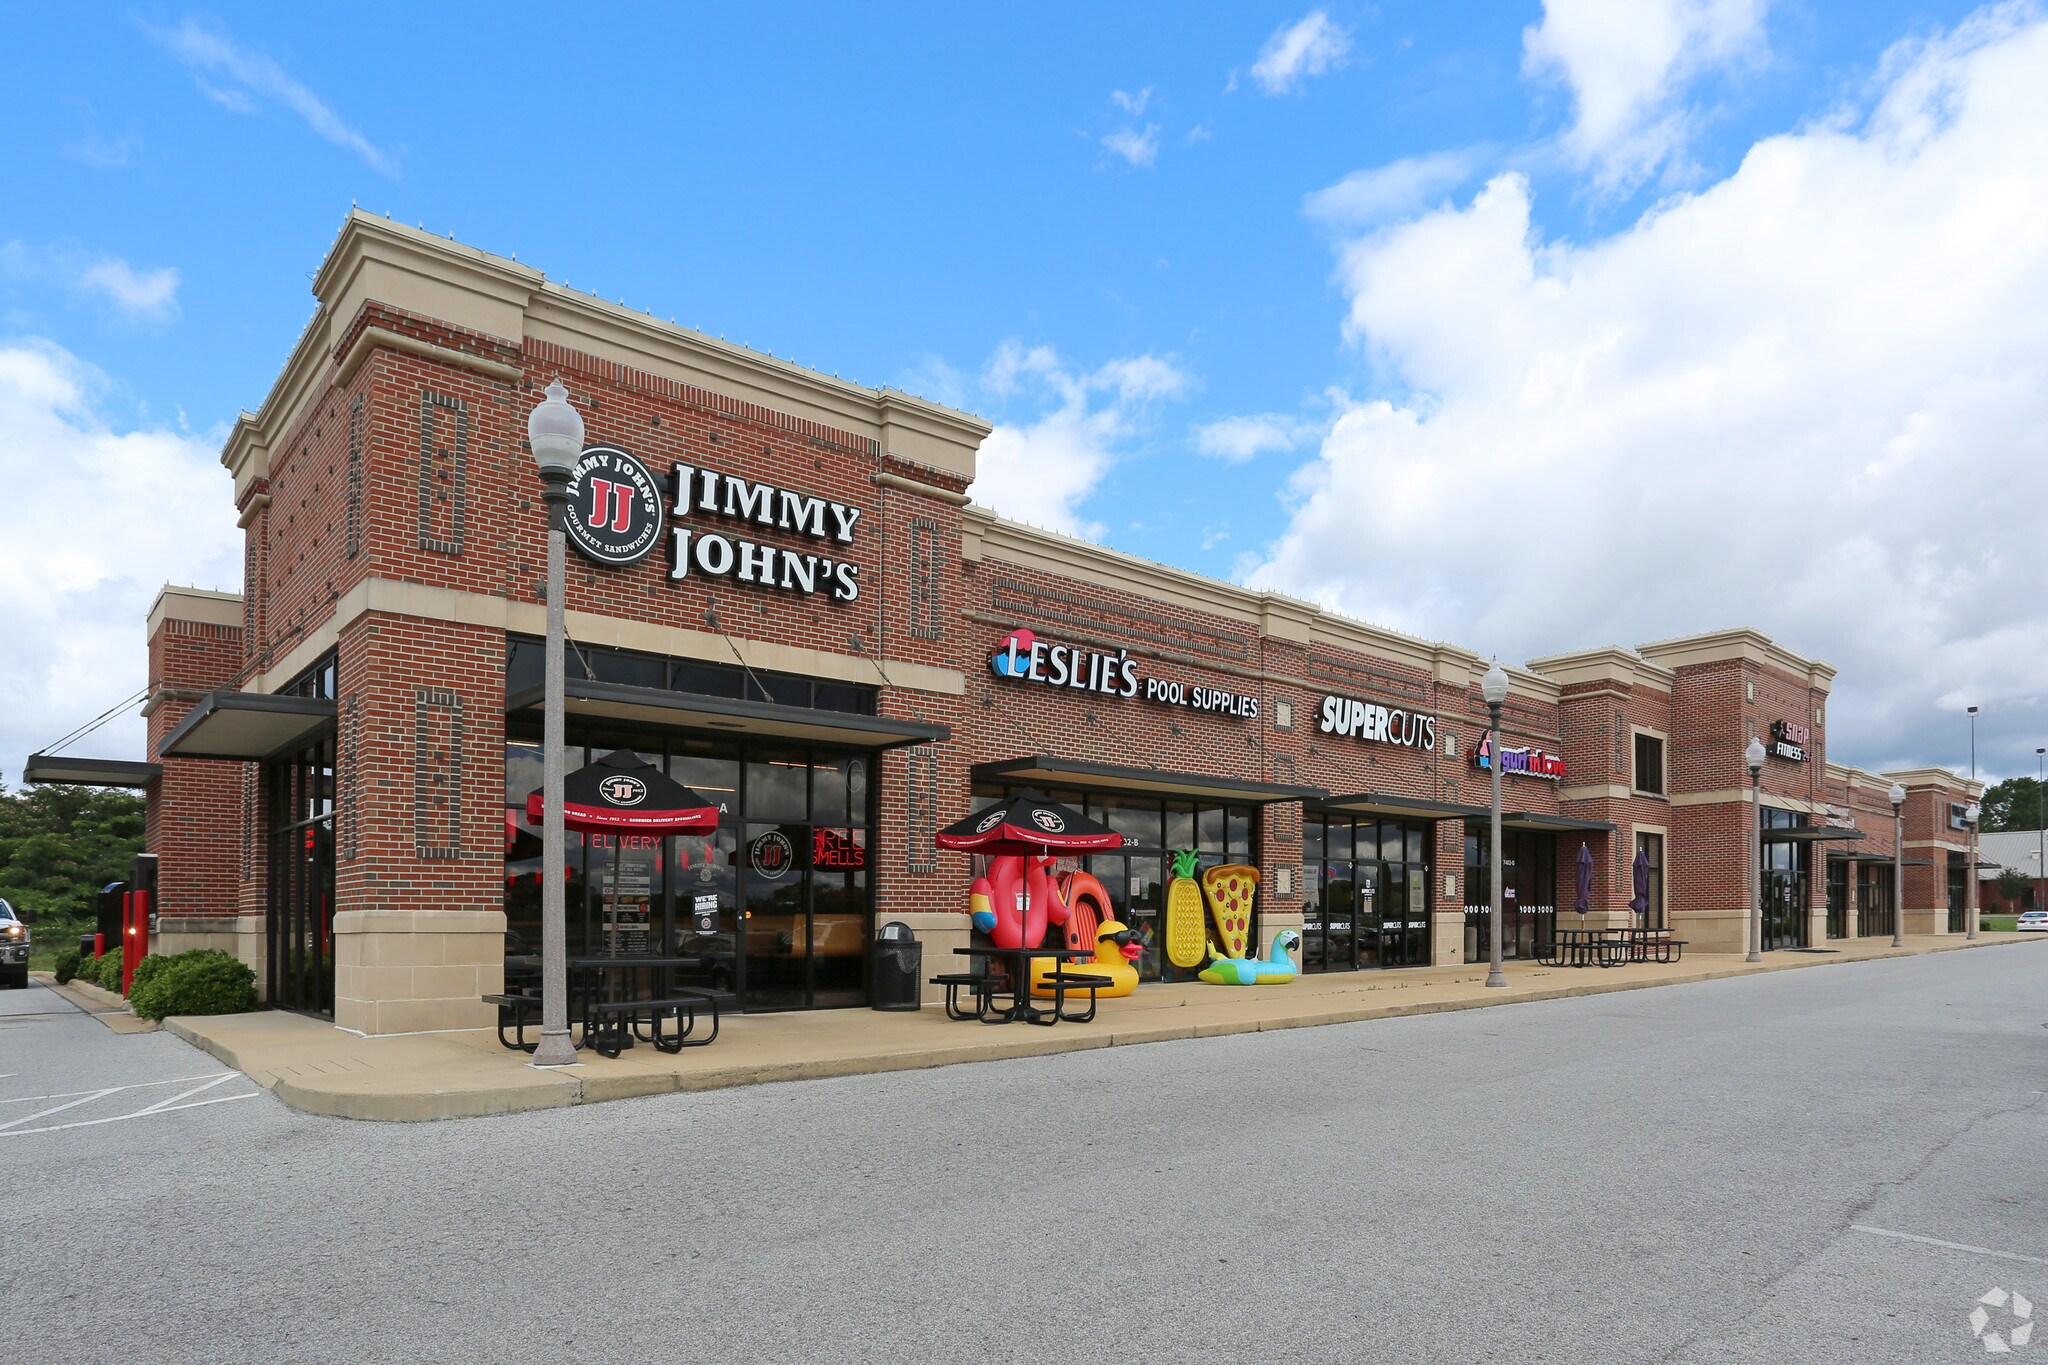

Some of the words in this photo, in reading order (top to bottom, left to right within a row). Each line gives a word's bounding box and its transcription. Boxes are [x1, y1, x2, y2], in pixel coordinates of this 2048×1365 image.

[566, 455, 609, 497] JIMMY
[614, 458, 656, 514] JOHN'S
[588, 476, 635, 533] JJ
[673, 463, 861, 543] JIMMY
[567, 504, 603, 549] GOURMET
[604, 522, 653, 553] SANDWICHES
[671, 526, 860, 601] JOHN'S
[1006, 636, 1138, 698] LESLIE'S
[1147, 677, 1188, 705] POOL
[1192, 686, 1259, 718] SUPPLIES
[1320, 695, 1436, 750] SUPERCUTS
[1776, 741, 1803, 761] FITNESS
[1529, 749, 1541, 773] in
[1541, 751, 1566, 777] love
[613, 784, 633, 799] JJ
[581, 833, 662, 851] ELVERY
[813, 828, 865, 850] FREE
[763, 845, 782, 867] JJ
[812, 850, 865, 866] SMELLS
[694, 900, 718, 912] HIRING
[1329, 922, 1351, 931] SUPERCUTS
[1382, 921, 1402, 929] SUPERCUTS
[1407, 921, 1427, 929] SUPERCUTS
